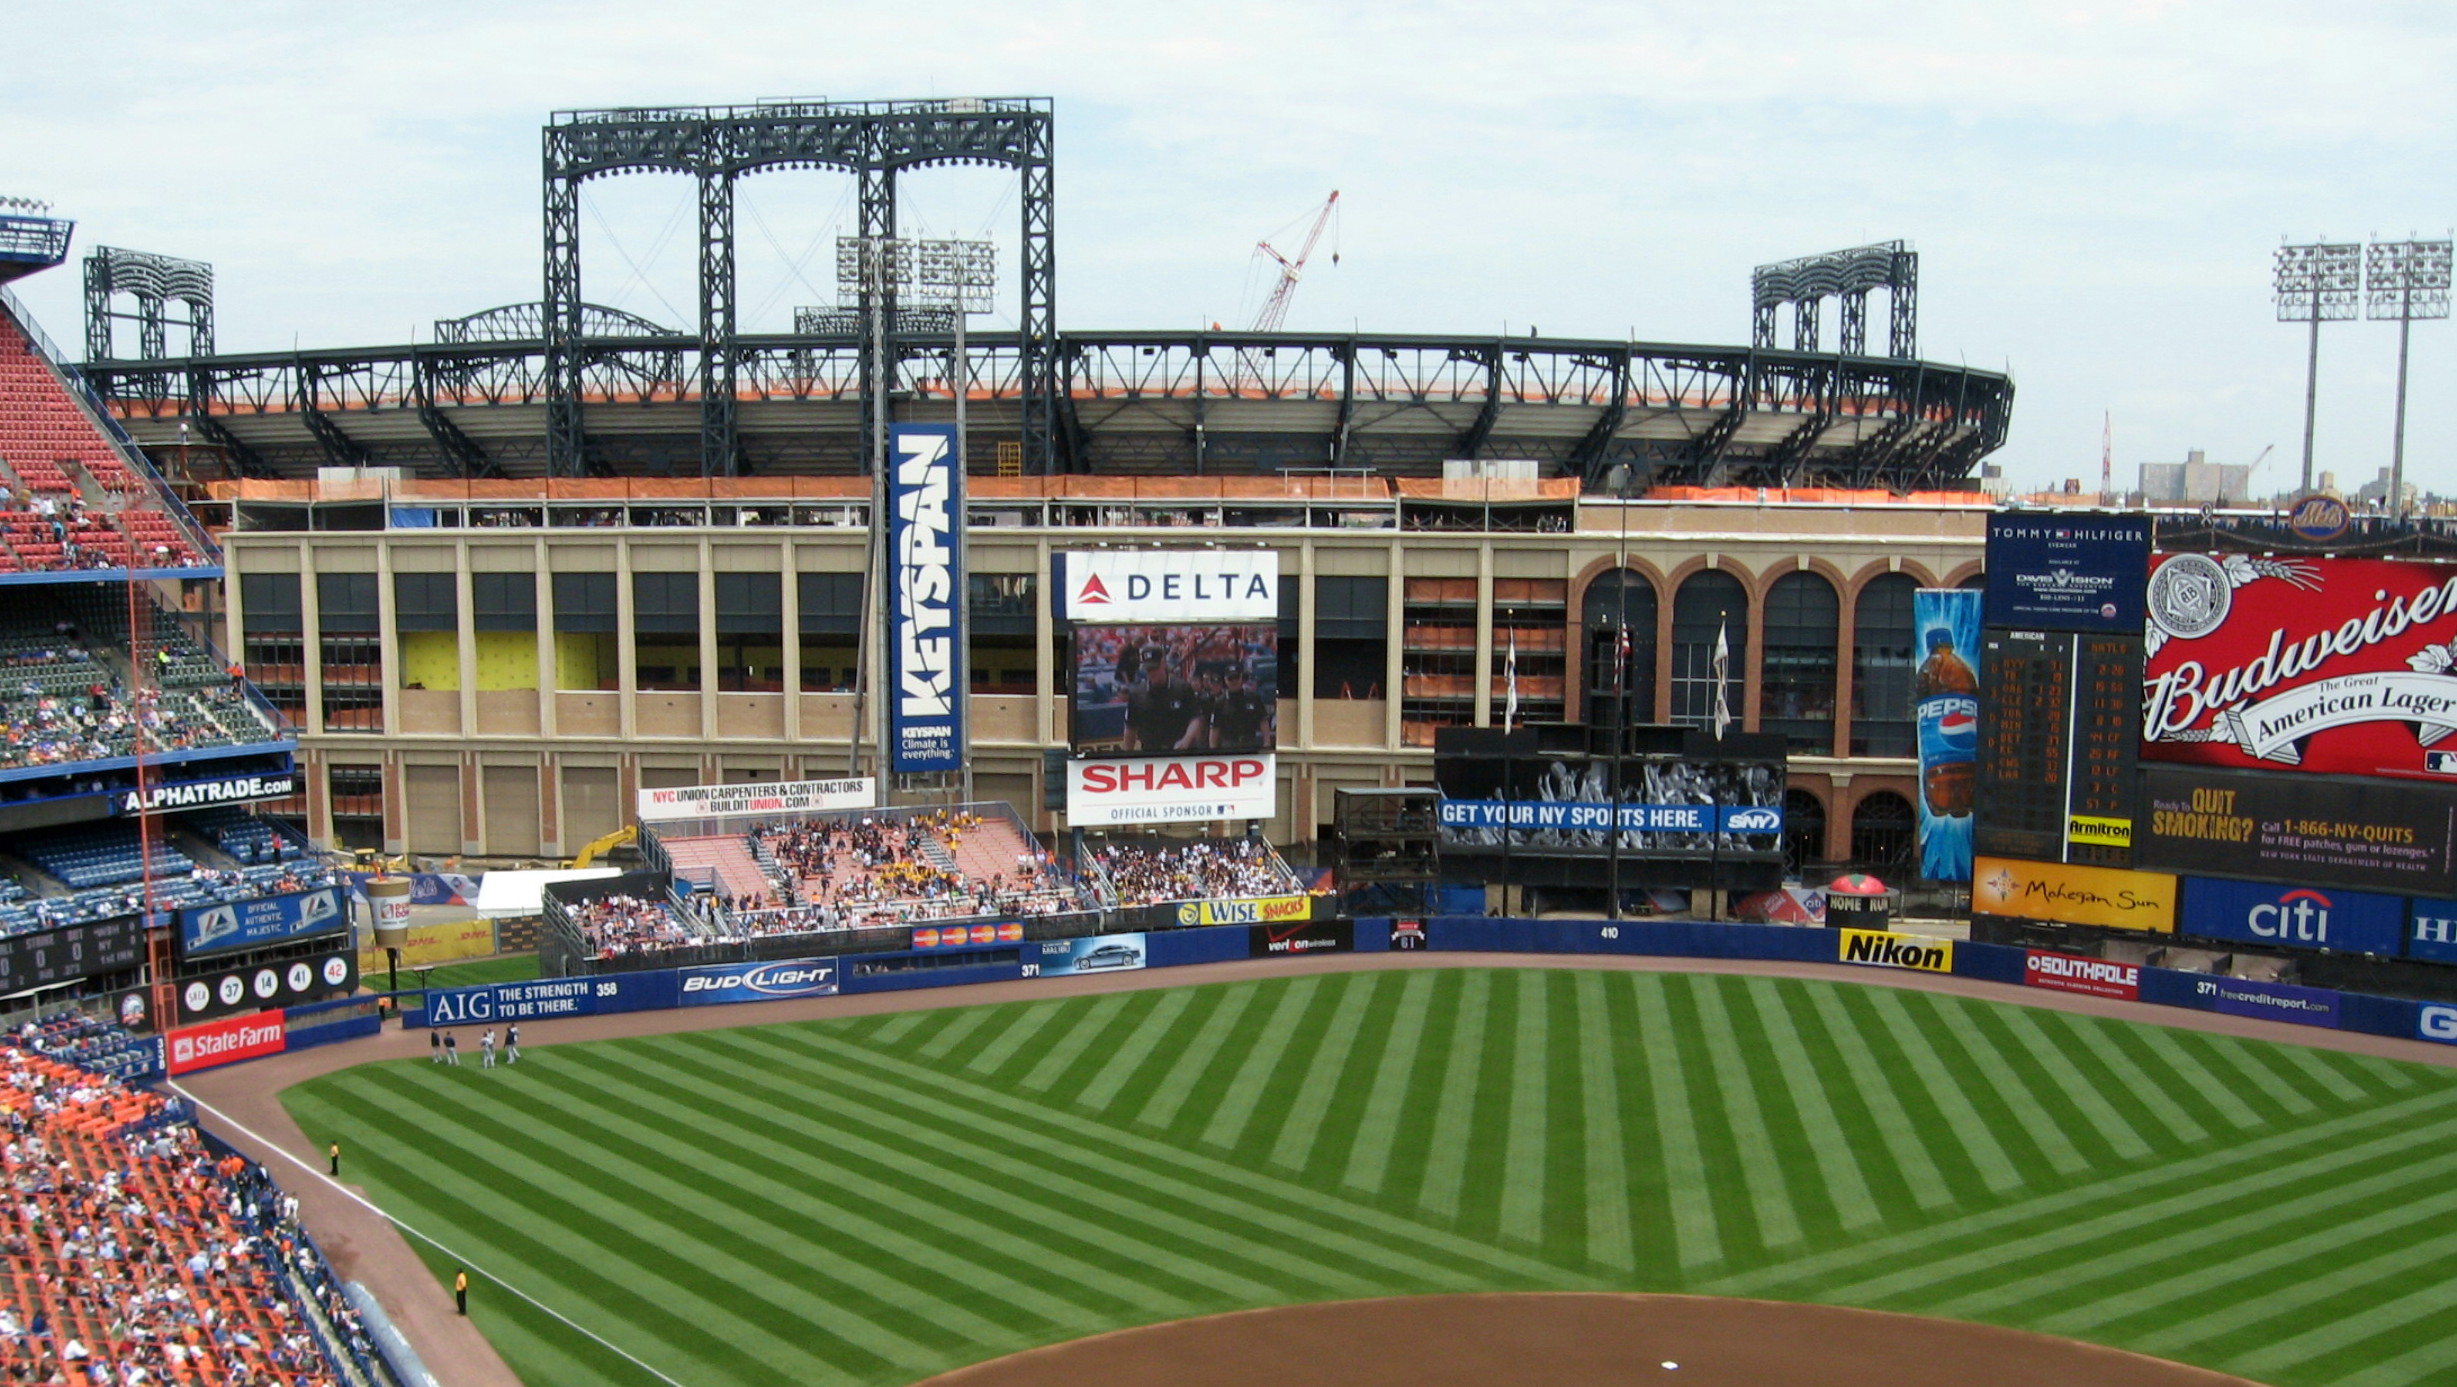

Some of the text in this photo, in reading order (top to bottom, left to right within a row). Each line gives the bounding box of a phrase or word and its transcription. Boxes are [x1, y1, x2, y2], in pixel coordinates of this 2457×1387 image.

[1993, 528, 2143, 541] TOMMY HILFIGER
[899, 435, 951, 716] KEYSPAN
[1128, 574, 1269, 600] DELTA
[2010, 632, 2045, 641] AMERICAN
[2318, 676, 2380, 693] The Great
[2258, 687, 2456, 742] American Lager
[902, 726, 951, 738] KEYSPAN
[902, 738, 948, 750] Climate is
[1082, 760, 1265, 793] SHARP
[653, 780, 863, 803] NYC UNION CARPENTERS & CONTRACTORS
[710, 797, 809, 812] BUILDITUNION.COM
[2153, 788, 2236, 815] Ready To QUIT
[1111, 805, 1212, 820] OFFICIAL SPONSOR
[1443, 805, 1702, 828] GET YOUR NY SPORTS HERE.
[1728, 814, 1774, 830] SNY
[2070, 820, 2130, 837] Armitron
[2152, 810, 2254, 842] SMOKING?
[2261, 819, 2414, 844] Call 1-866-NY-QUITS
[2261, 834, 2275, 845] for
[2278, 836, 2301, 847] FREE
[2303, 838, 2343, 851] patches,
[2346, 844, 2367, 854] gum
[2370, 844, 2379, 853] or
[2260, 851, 2427, 872] NEW YORK STATE DEPARTMENT OF HEALTH
[1806, 900, 1821, 908] citi
[1830, 896, 1888, 911] HOME RUN
[2025, 881, 2159, 910] Mohegan Sun
[1209, 900, 1304, 923] WISE SNACKS
[2248, 899, 2328, 942] citi
[1601, 927, 1619, 939] 410
[36, 949, 45, 968] 0
[1846, 934, 1945, 969] Nikon
[294, 970, 306, 983] 41
[329, 963, 343, 977] 42
[1022, 964, 1039, 977] 371
[2040, 956, 2138, 986] SOUTHPOLE
[261, 977, 272, 991] 14
[596, 982, 617, 997] 358
[683, 967, 833, 993] BUD LIGHT
[2197, 981, 2216, 996] 371
[225, 983, 239, 998] 37
[498, 982, 588, 1002] THE STRENGTH
[2220, 988, 2329, 1012] freecreditreport.com
[433, 992, 490, 1022] AIG
[500, 1004, 515, 1018] TO
[519, 1002, 534, 1015] BE
